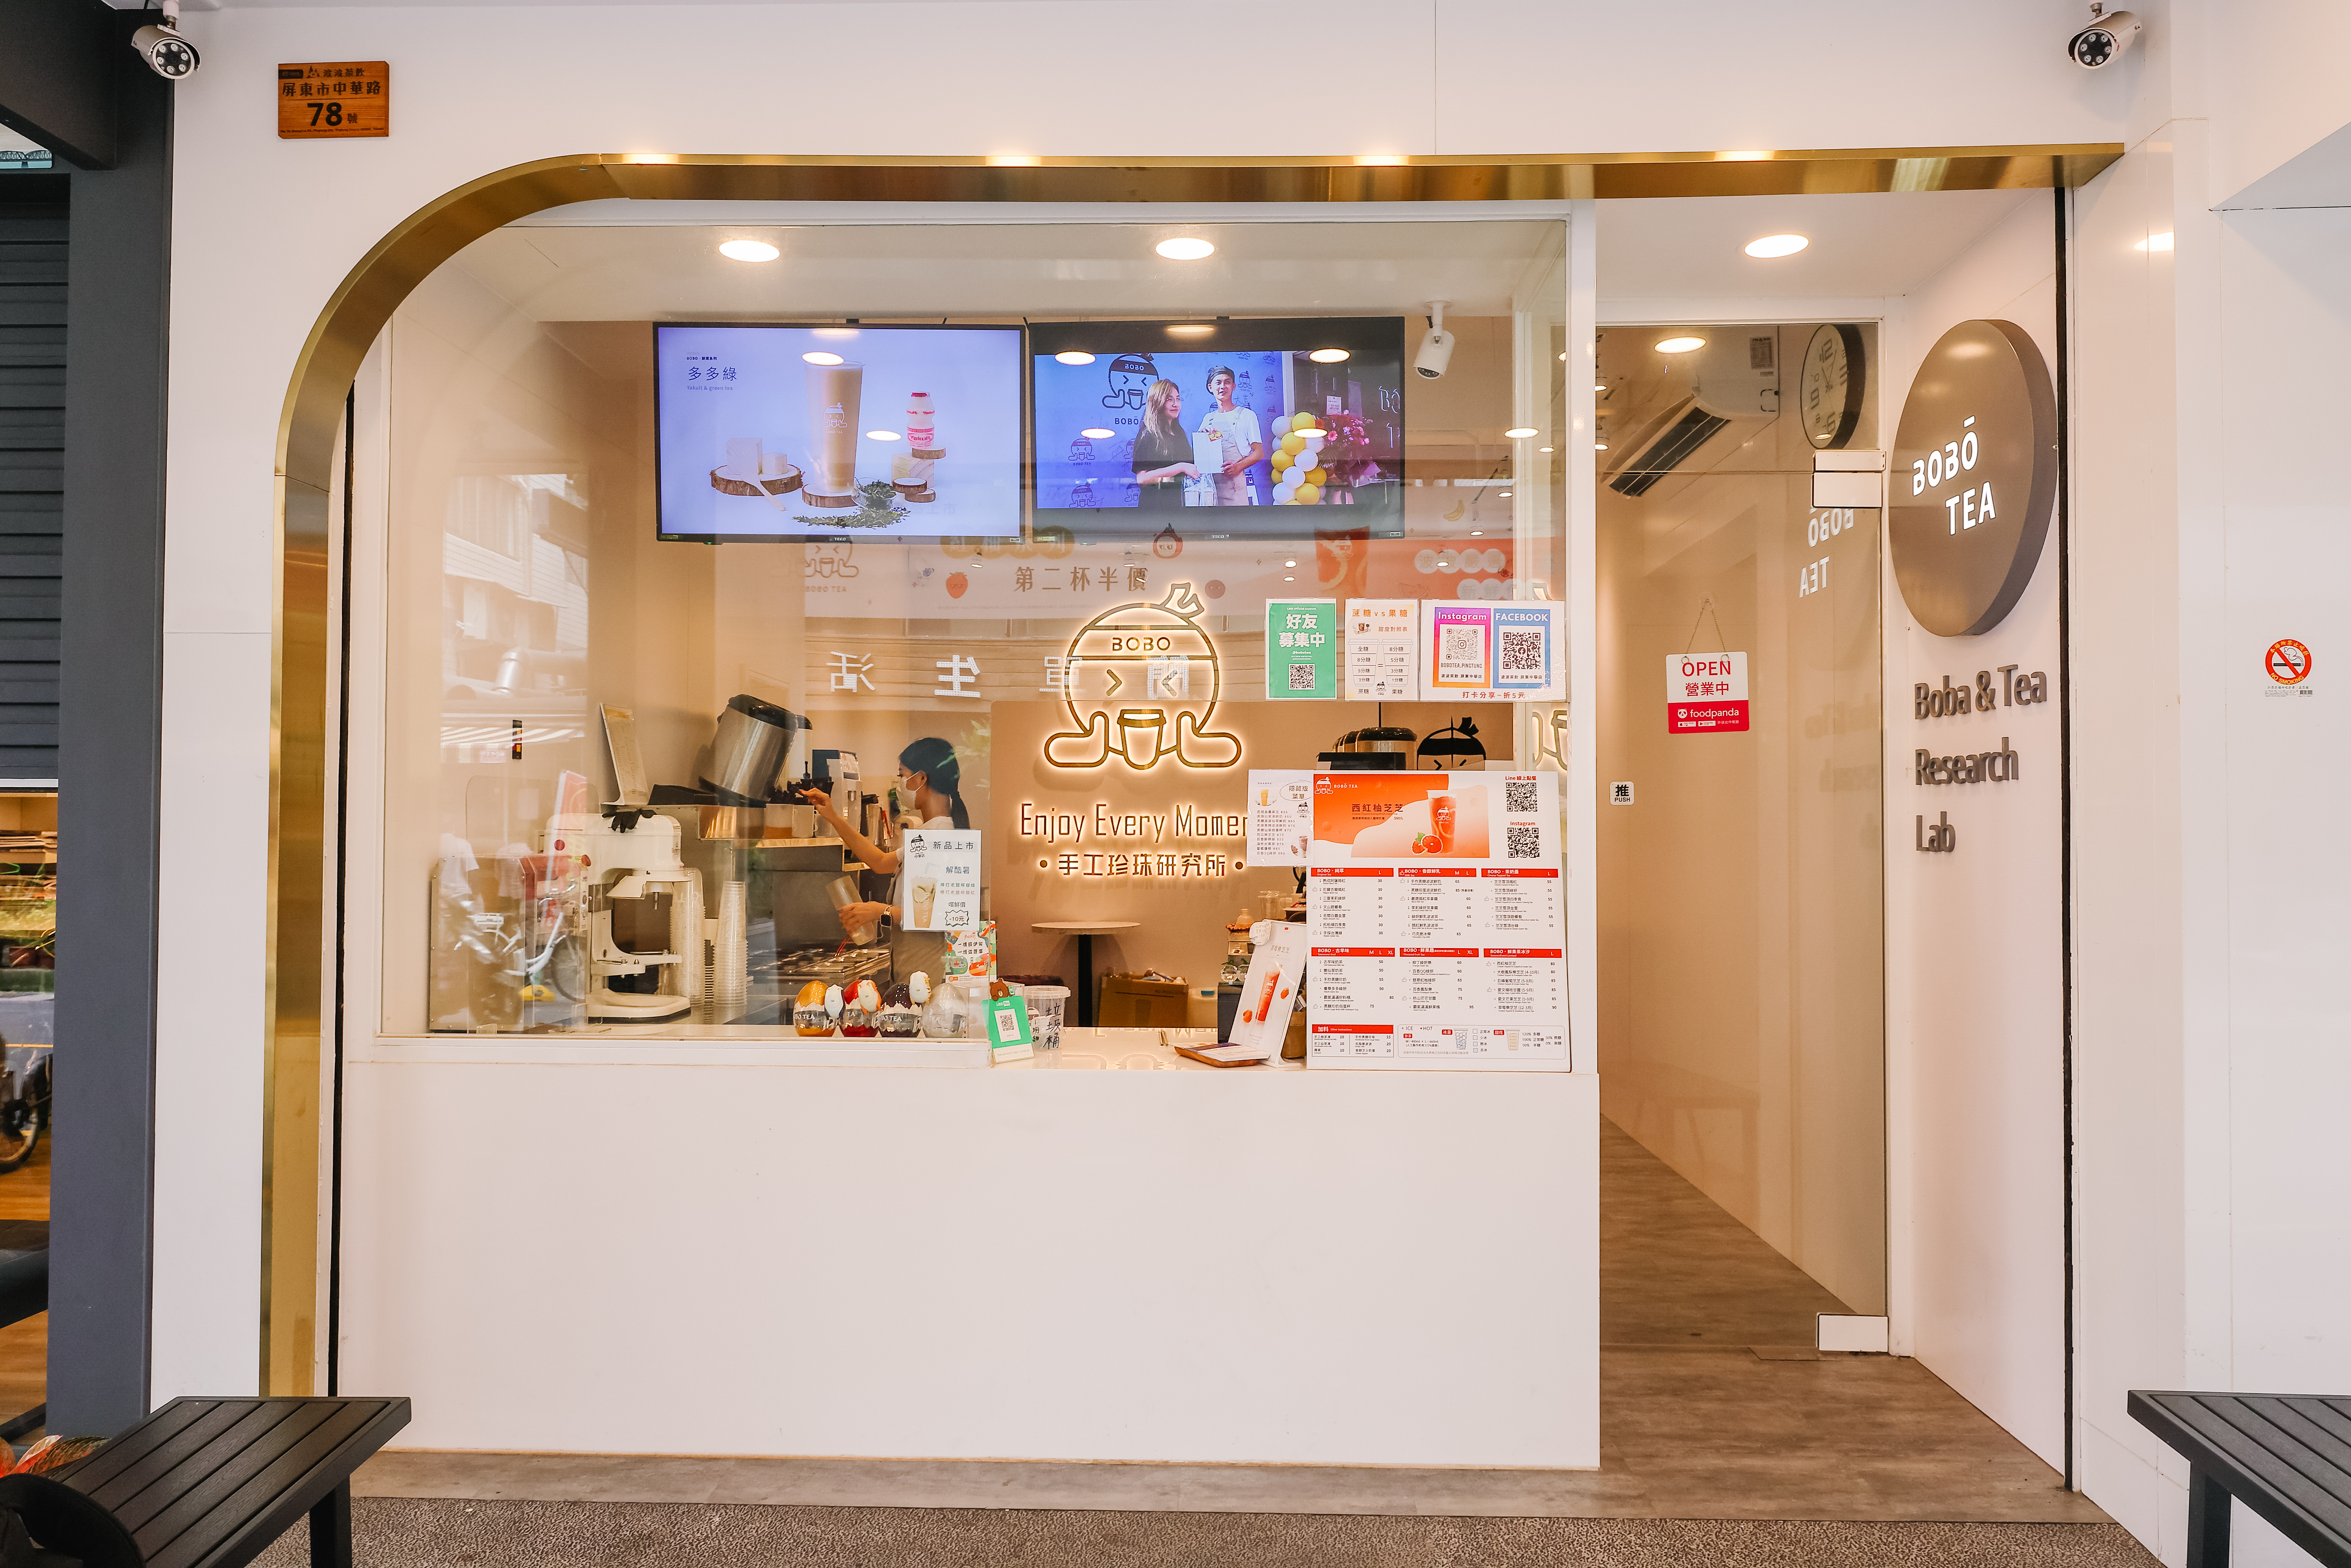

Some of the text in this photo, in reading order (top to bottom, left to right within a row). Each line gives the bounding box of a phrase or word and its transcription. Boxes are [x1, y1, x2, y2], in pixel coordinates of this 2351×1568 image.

[323, 68, 365, 78] 波波茶飲
[282, 80, 381, 97] 屏東市中華路
[307, 102, 358, 127] 78 號
[688, 366, 737, 381] 多多綠
[1124, 363, 1145, 371] BOBO
[1945, 481, 1996, 536] TEA
[1013, 566, 1149, 592] 第二杯半價
[1286, 613, 1318, 630] 好友
[1438, 611, 1548, 622] Instagram FACEBOOK
[1112, 636, 1171, 651] BOBO
[1279, 632, 1325, 648] 募集中
[1682, 661, 1731, 677] OPEN
[2270, 672, 2305, 685] NO SMOKING
[1685, 681, 1729, 697] 營業中
[1915, 664, 2047, 720] Boba & Tea
[1689, 707, 1740, 719] foodpanda
[1915, 737, 2019, 785] Research
[1615, 784, 1630, 797] 推
[1352, 803, 1403, 812] 西紅柚芝芝
[1021, 803, 1085, 843] Enjoy
[1095, 804, 1166, 843] Every
[1916, 811, 1956, 852] Lab
[933, 841, 974, 850] 新品上市
[946, 866, 970, 874] 解酷暑
[1058, 854, 1226, 877] 手工珍珠研究所
